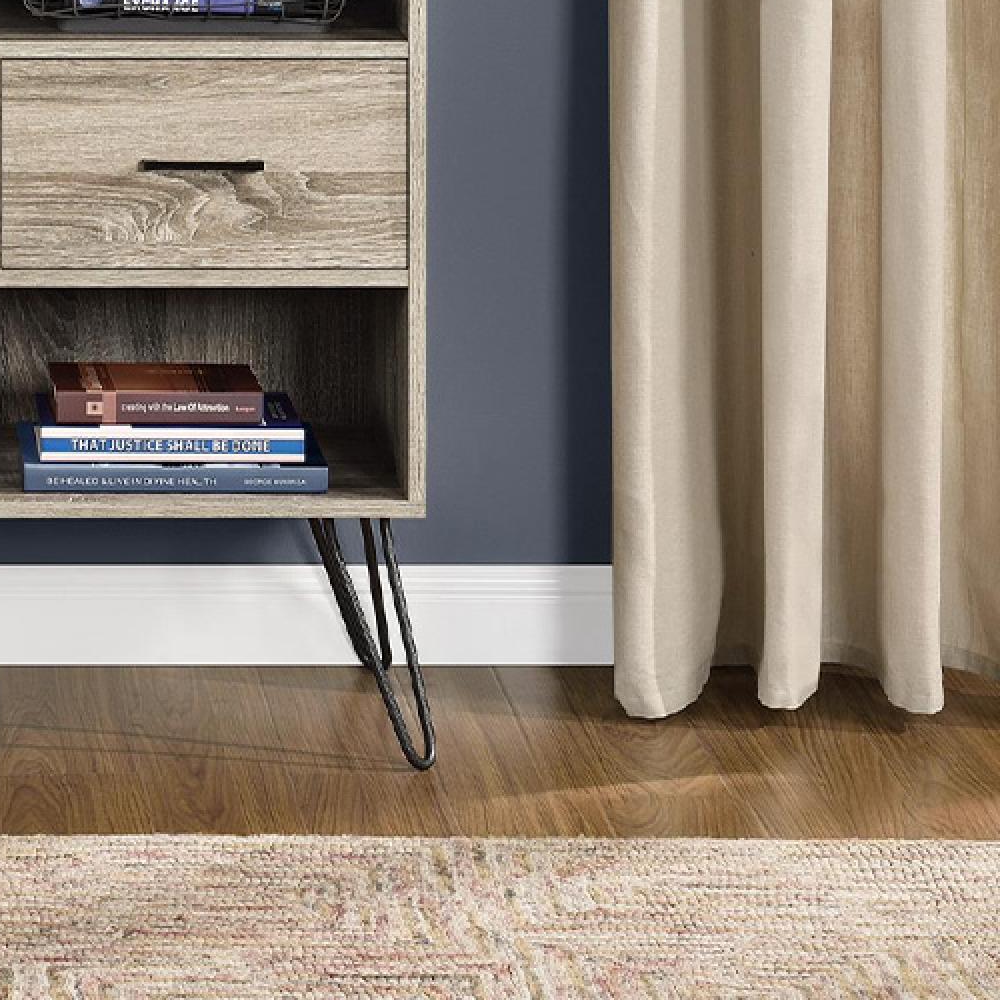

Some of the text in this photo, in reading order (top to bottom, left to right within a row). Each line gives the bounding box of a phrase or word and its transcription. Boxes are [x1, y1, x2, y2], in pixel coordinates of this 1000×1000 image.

[72, 438, 271, 452] THAT JUSTICE SHALL BE DONE
